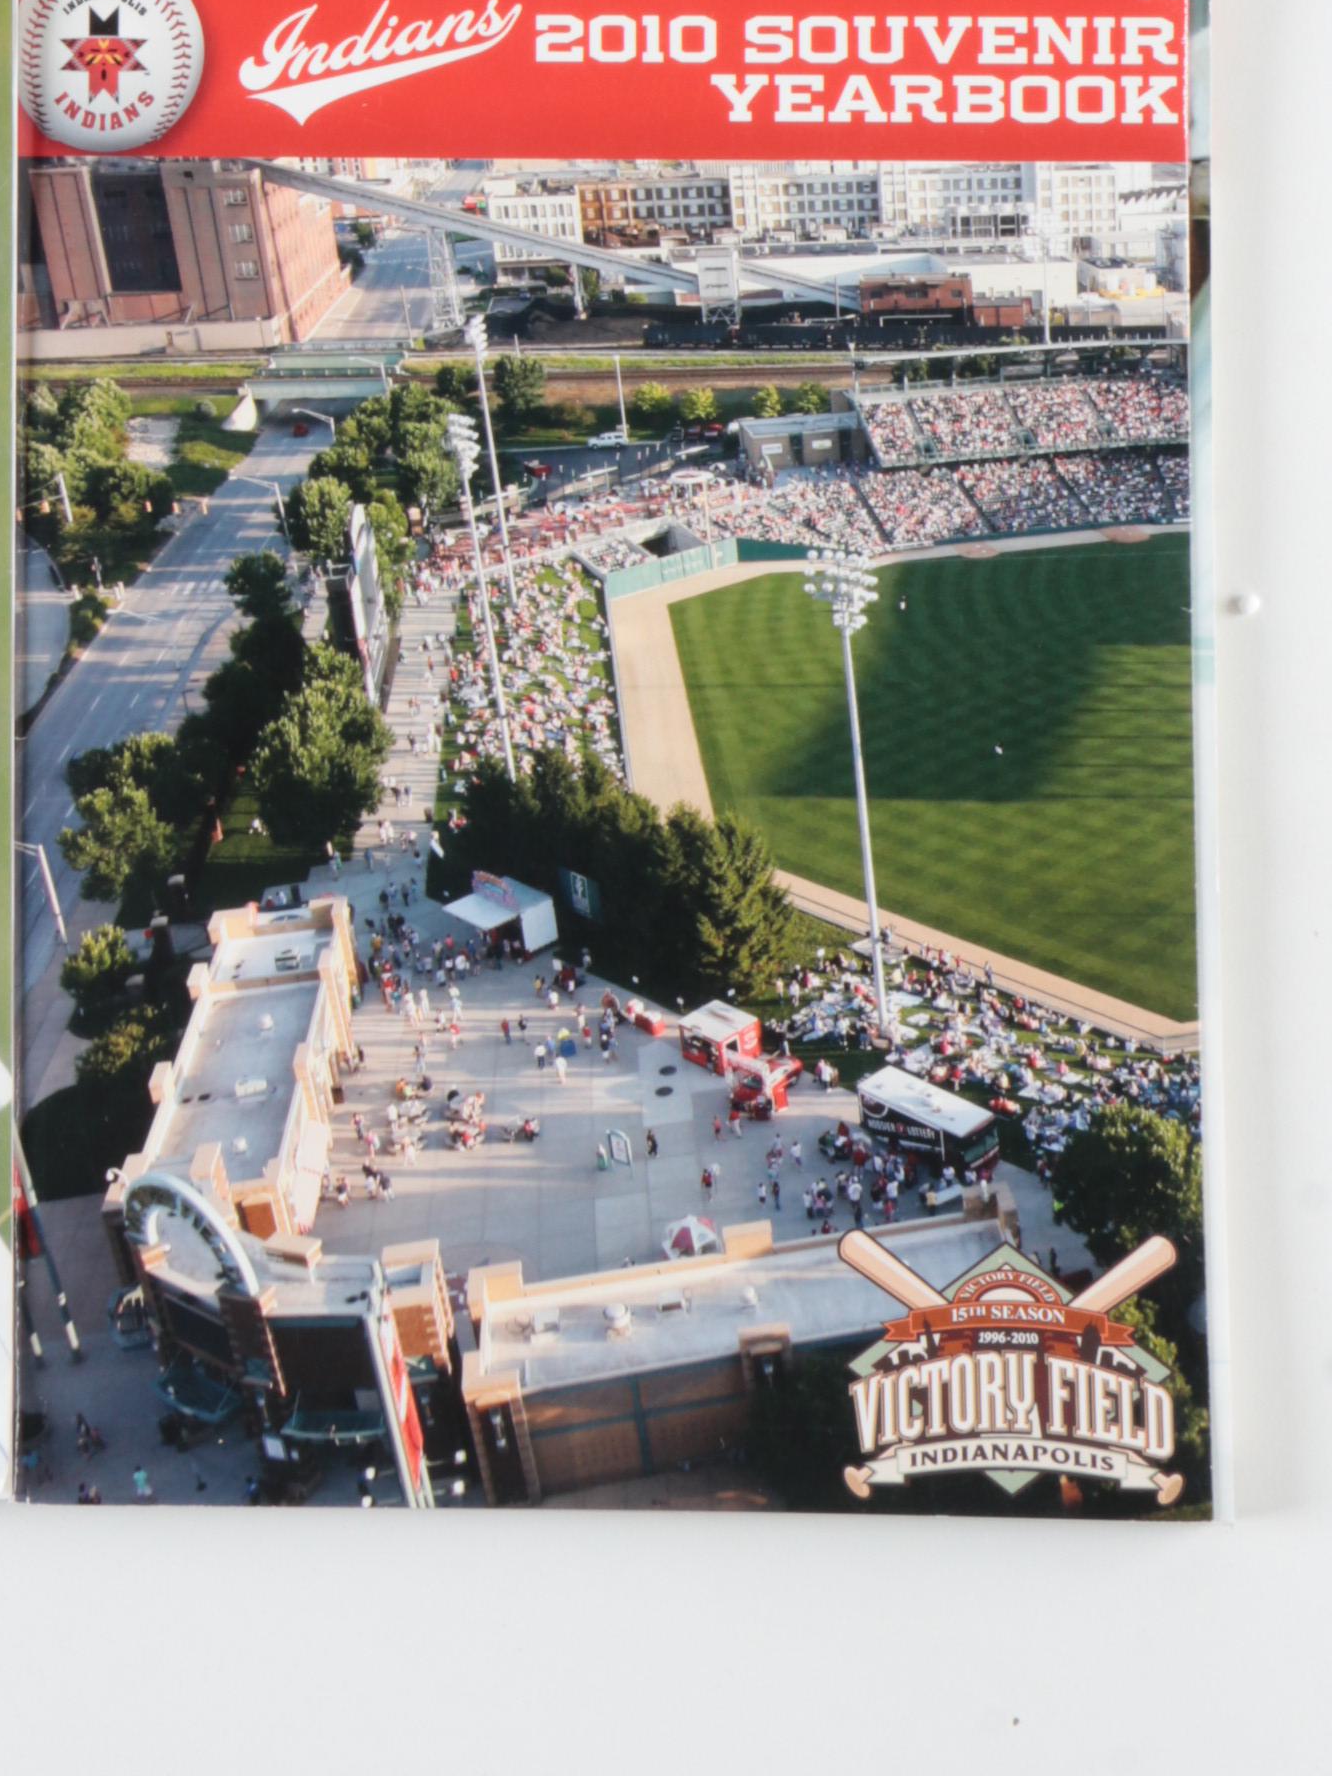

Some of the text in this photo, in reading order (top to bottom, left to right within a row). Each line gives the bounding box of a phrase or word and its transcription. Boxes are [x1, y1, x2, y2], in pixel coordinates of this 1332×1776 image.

[535, 14, 1178, 65] 2010 SOUVENIR
[54, 90, 155, 132] INDIANS
[710, 74, 1178, 124] YEARBOOK
[960, 1271, 1056, 1302] VICTORY FIELD
[952, 1305, 1066, 1324] 15TH SEASON
[978, 1330, 1039, 1345] 1996-2010
[849, 1351, 1174, 1460] VICTORY FIELD
[910, 1443, 1114, 1471] INDIANAPOLIS
